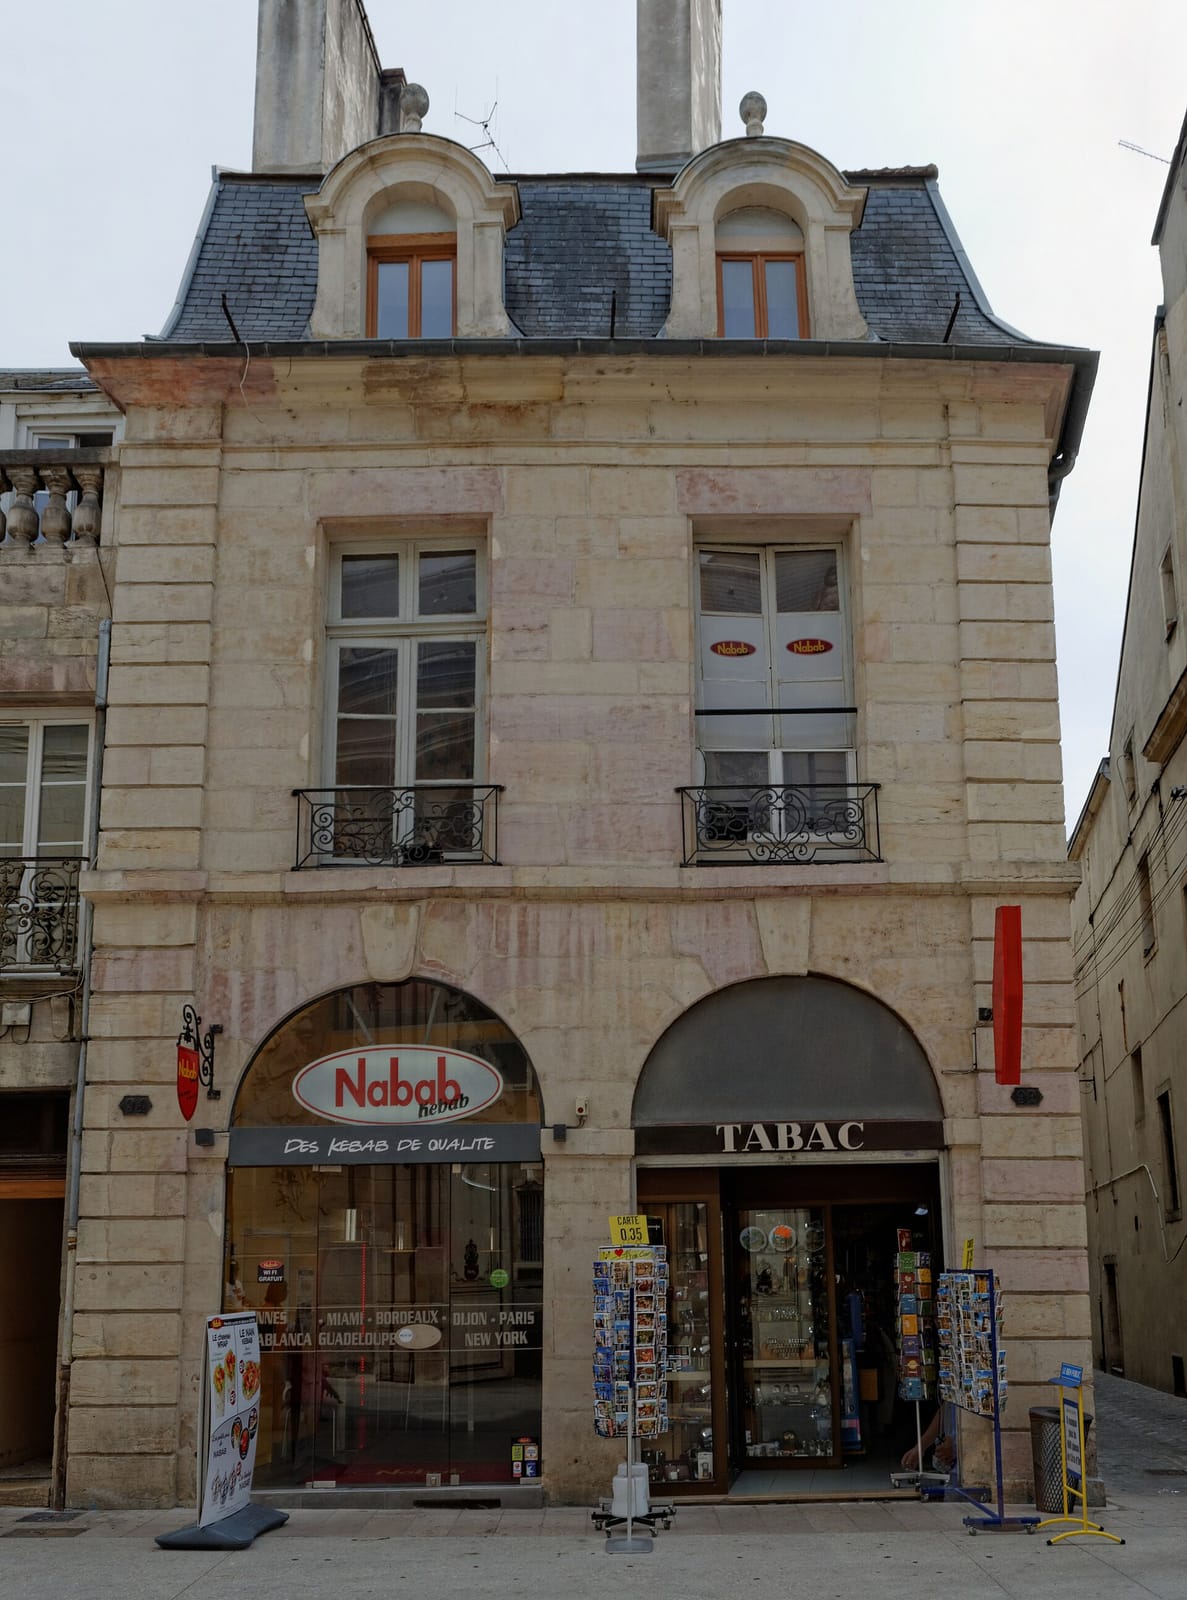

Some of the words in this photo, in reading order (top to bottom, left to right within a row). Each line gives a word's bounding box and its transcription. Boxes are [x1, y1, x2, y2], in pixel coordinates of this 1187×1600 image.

[717, 642, 748, 655] Nabab
[793, 640, 825, 653] Nabab
[335, 1056, 461, 1108] Nabab
[716, 1121, 865, 1152] TABAC
[284, 1138, 319, 1153] DES
[327, 1137, 389, 1157] KEBAB
[397, 1138, 424, 1152] DE
[427, 1137, 496, 1152] QUALITE
[617, 1216, 640, 1226] CARTE
[620, 1227, 643, 1241] 0.35
[256, 1311, 287, 1325] NNES
[326, 1311, 364, 1326] MIAMI
[375, 1309, 439, 1325] BORDEAUX
[452, 1311, 488, 1326] DIJON
[499, 1310, 535, 1325] PARIS
[258, 1332, 312, 1347] ABLANCA
[318, 1331, 396, 1347] GUADELOUPE
[464, 1332, 492, 1347] NEW
[494, 1330, 529, 1346] YORK
